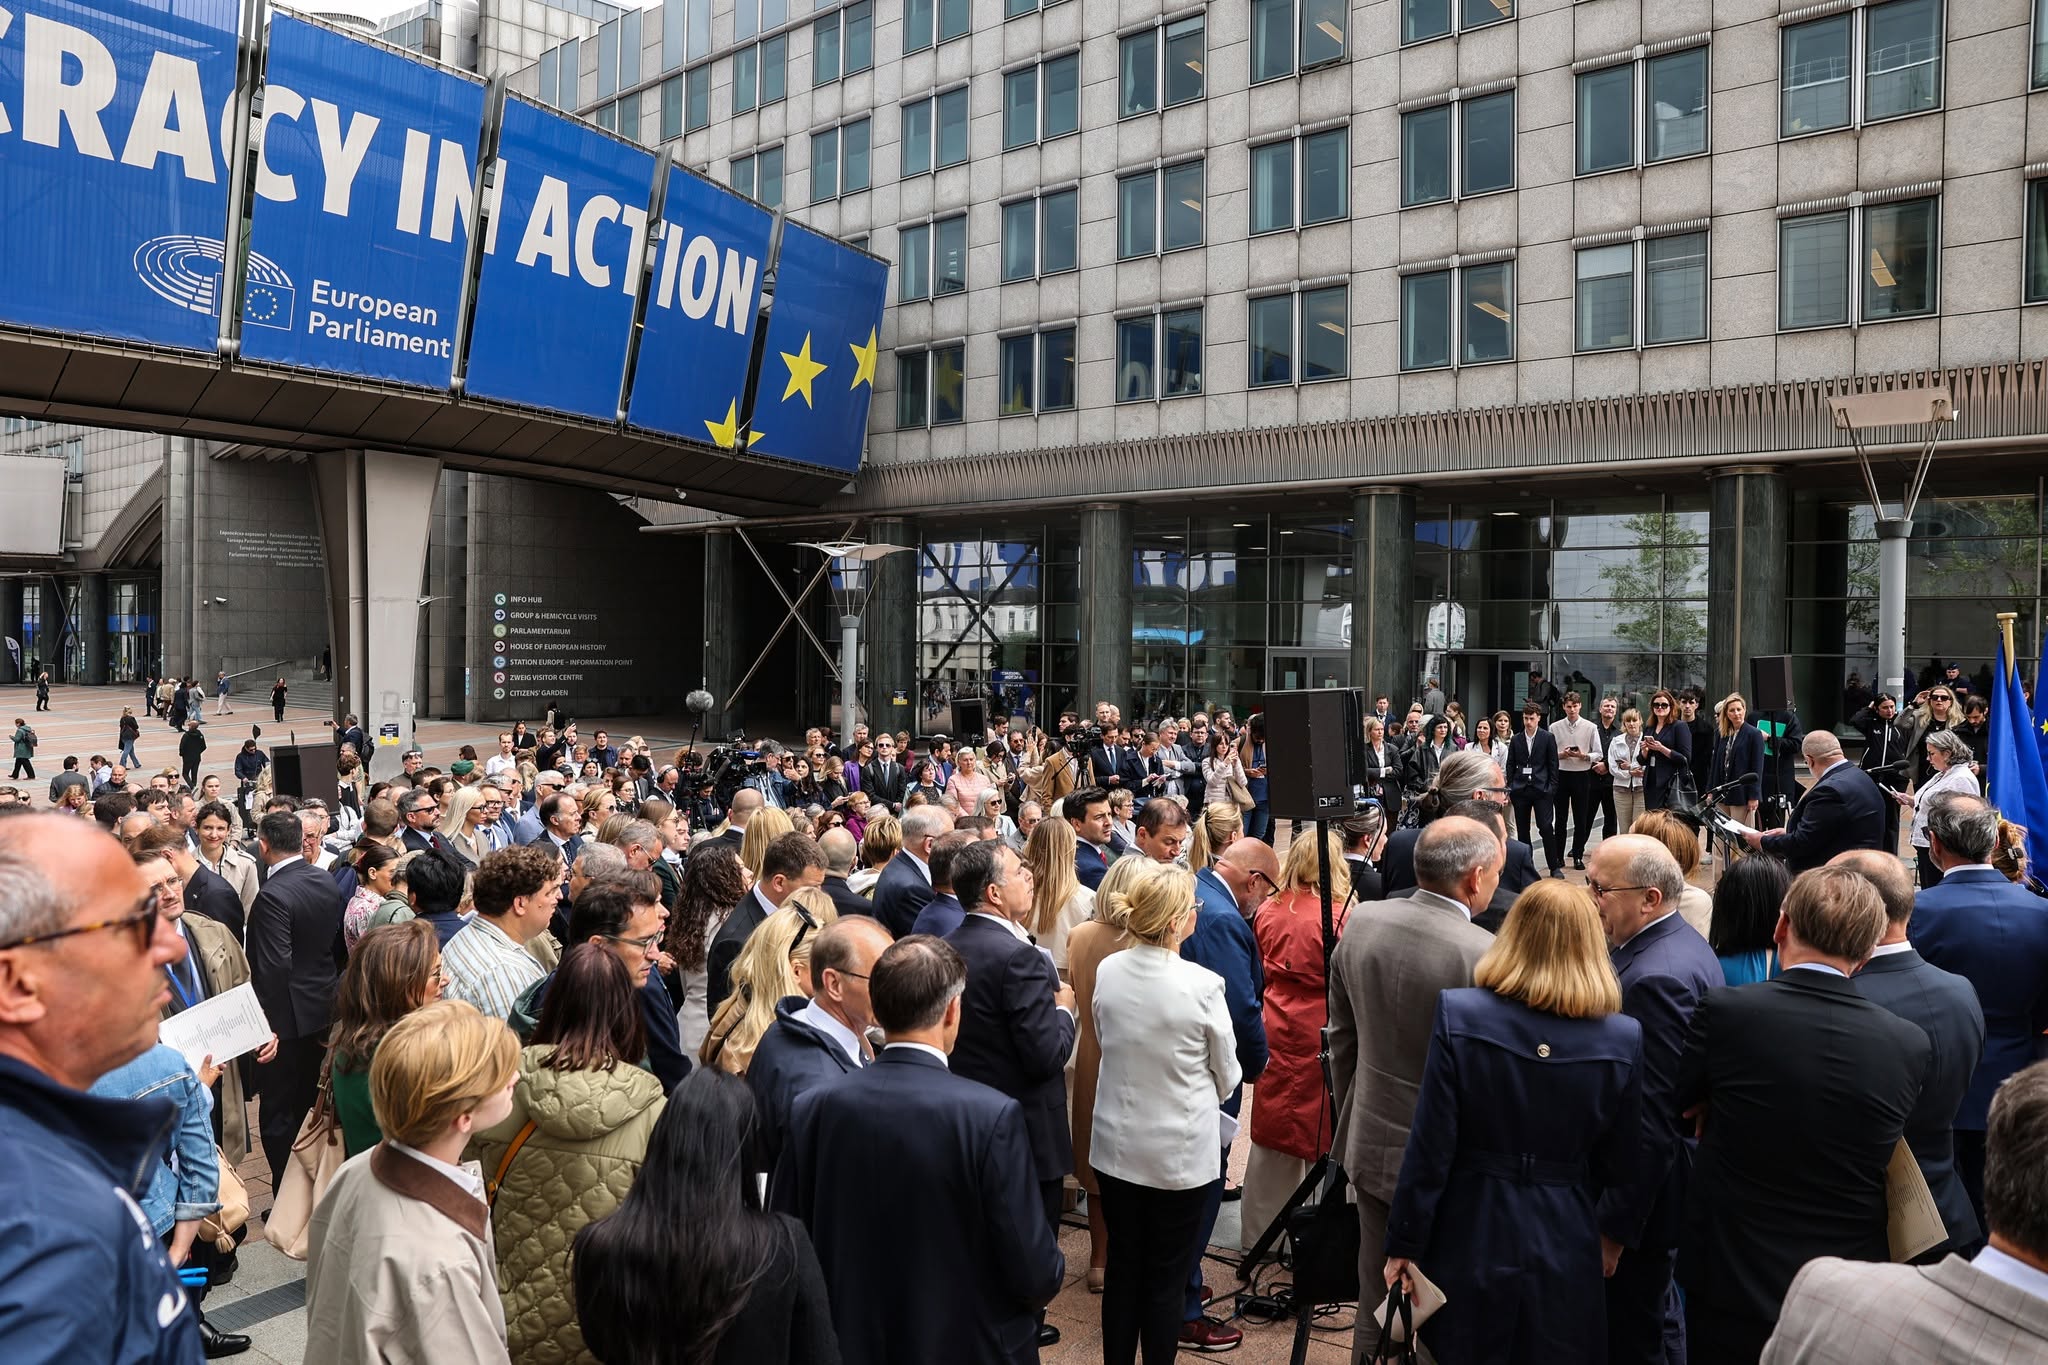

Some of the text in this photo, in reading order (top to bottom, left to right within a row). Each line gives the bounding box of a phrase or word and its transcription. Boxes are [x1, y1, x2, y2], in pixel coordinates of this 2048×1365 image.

[0, 5, 758, 335] RACY IN ACTION
[312, 279, 437, 326] European
[308, 314, 451, 358] Parliament
